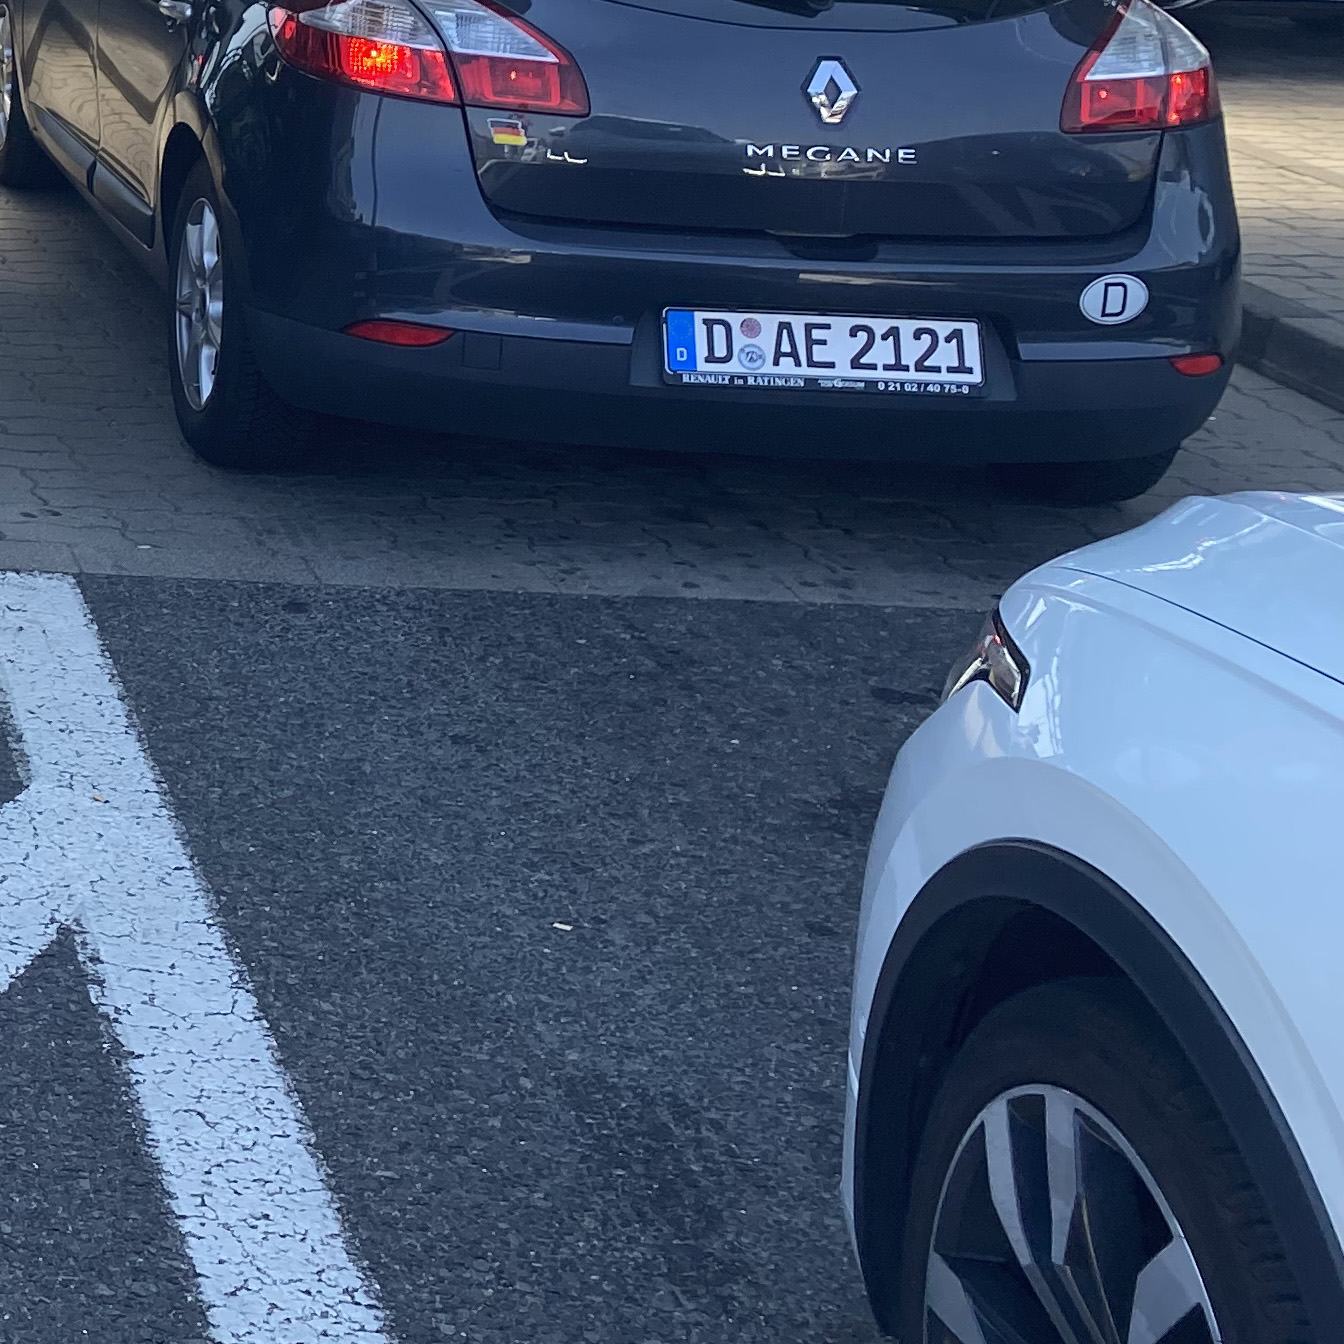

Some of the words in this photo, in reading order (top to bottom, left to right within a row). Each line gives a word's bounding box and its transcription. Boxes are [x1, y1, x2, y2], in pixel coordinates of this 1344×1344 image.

[746, 143, 917, 165] MEGANE
[1100, 281, 1128, 318] D
[675, 347, 688, 362] D
[702, 318, 734, 364] D
[772, 320, 836, 369] AE
[848, 323, 974, 376] 2121
[682, 373, 731, 384] RENAULT
[733, 375, 744, 385] in
[746, 375, 805, 387] RATINGEN
